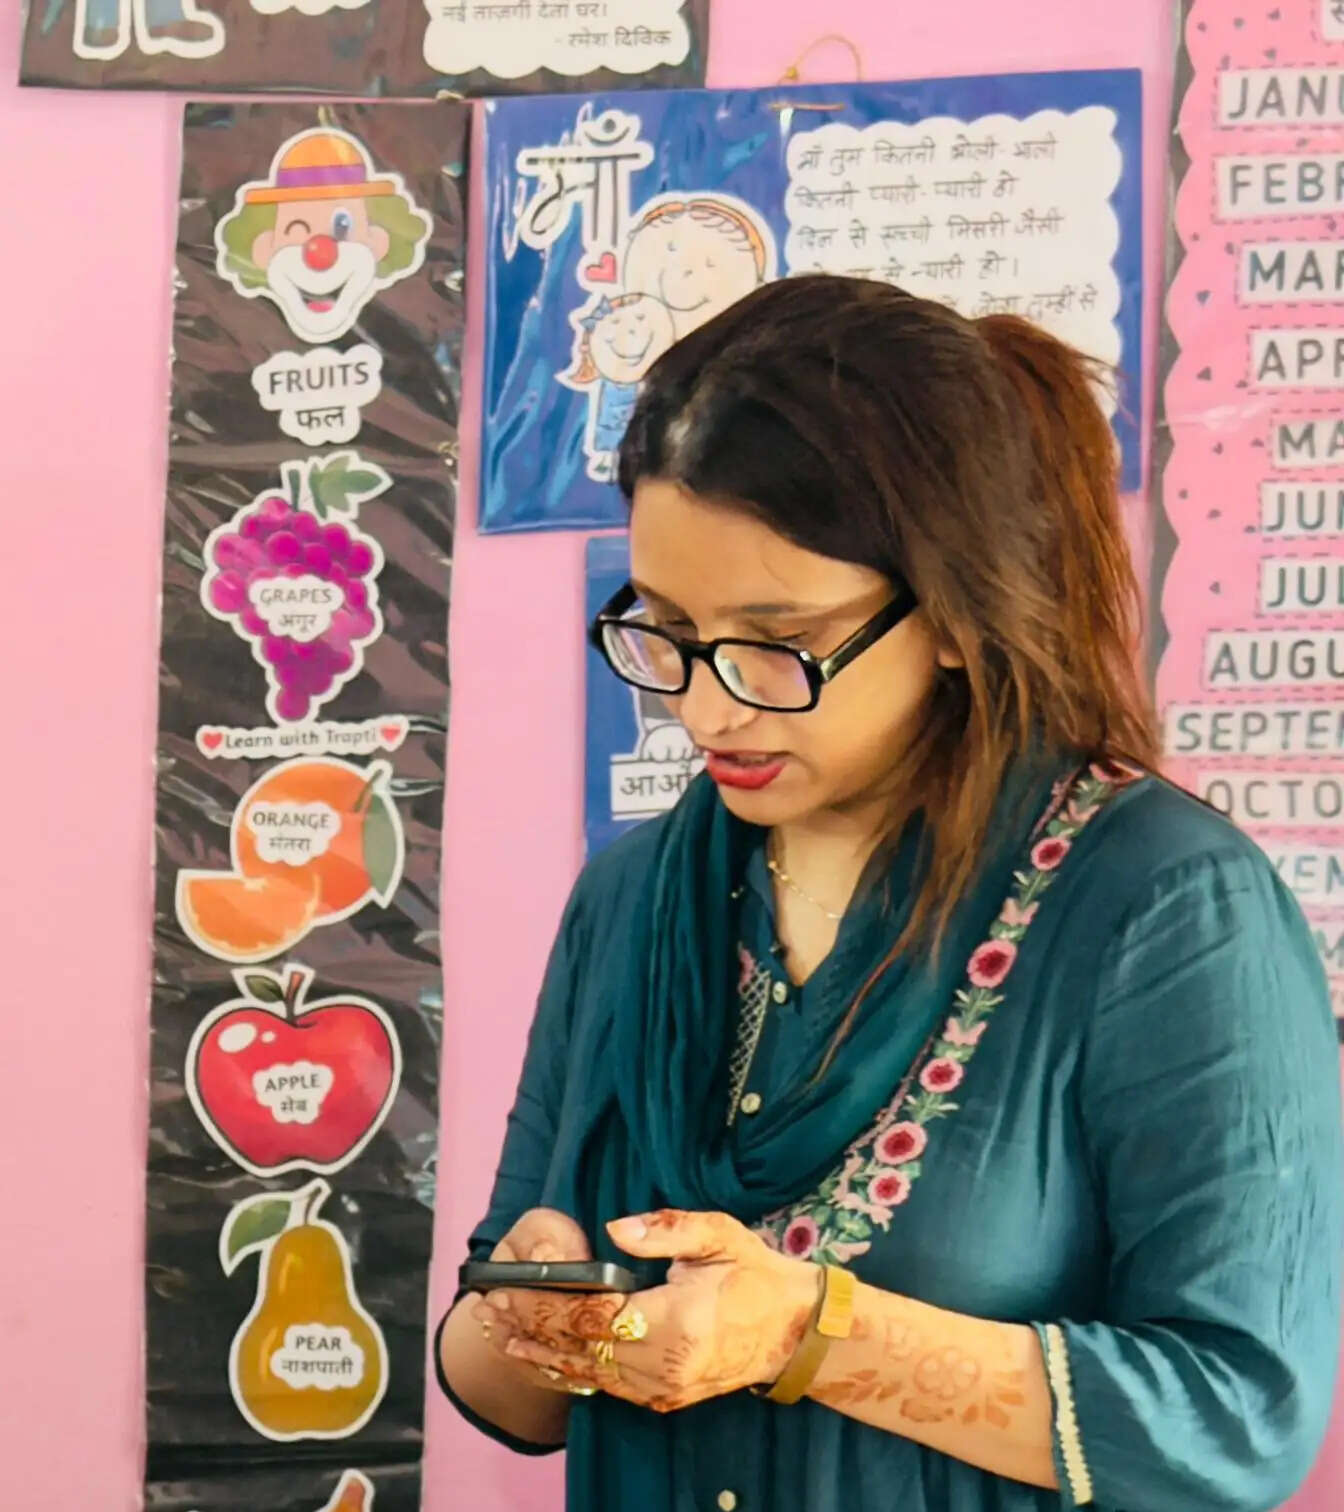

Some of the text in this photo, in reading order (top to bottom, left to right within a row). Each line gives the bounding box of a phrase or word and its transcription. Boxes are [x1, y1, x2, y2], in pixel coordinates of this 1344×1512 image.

[1228, 74, 1344, 119] JAN
[269, 362, 370, 395] FRUITS
[296, 406, 346, 430] फल
[1265, 490, 1344, 532] JU
[259, 588, 333, 605] GRAPES
[225, 734, 272, 749] Learn
[280, 730, 318, 745] with
[1176, 710, 1344, 751] SEPTE
[253, 811, 330, 829] ORANGE
[264, 1073, 320, 1093] APPLE
[295, 1336, 342, 1350] PEAR
[280, 1356, 355, 1375] नाशपाती
